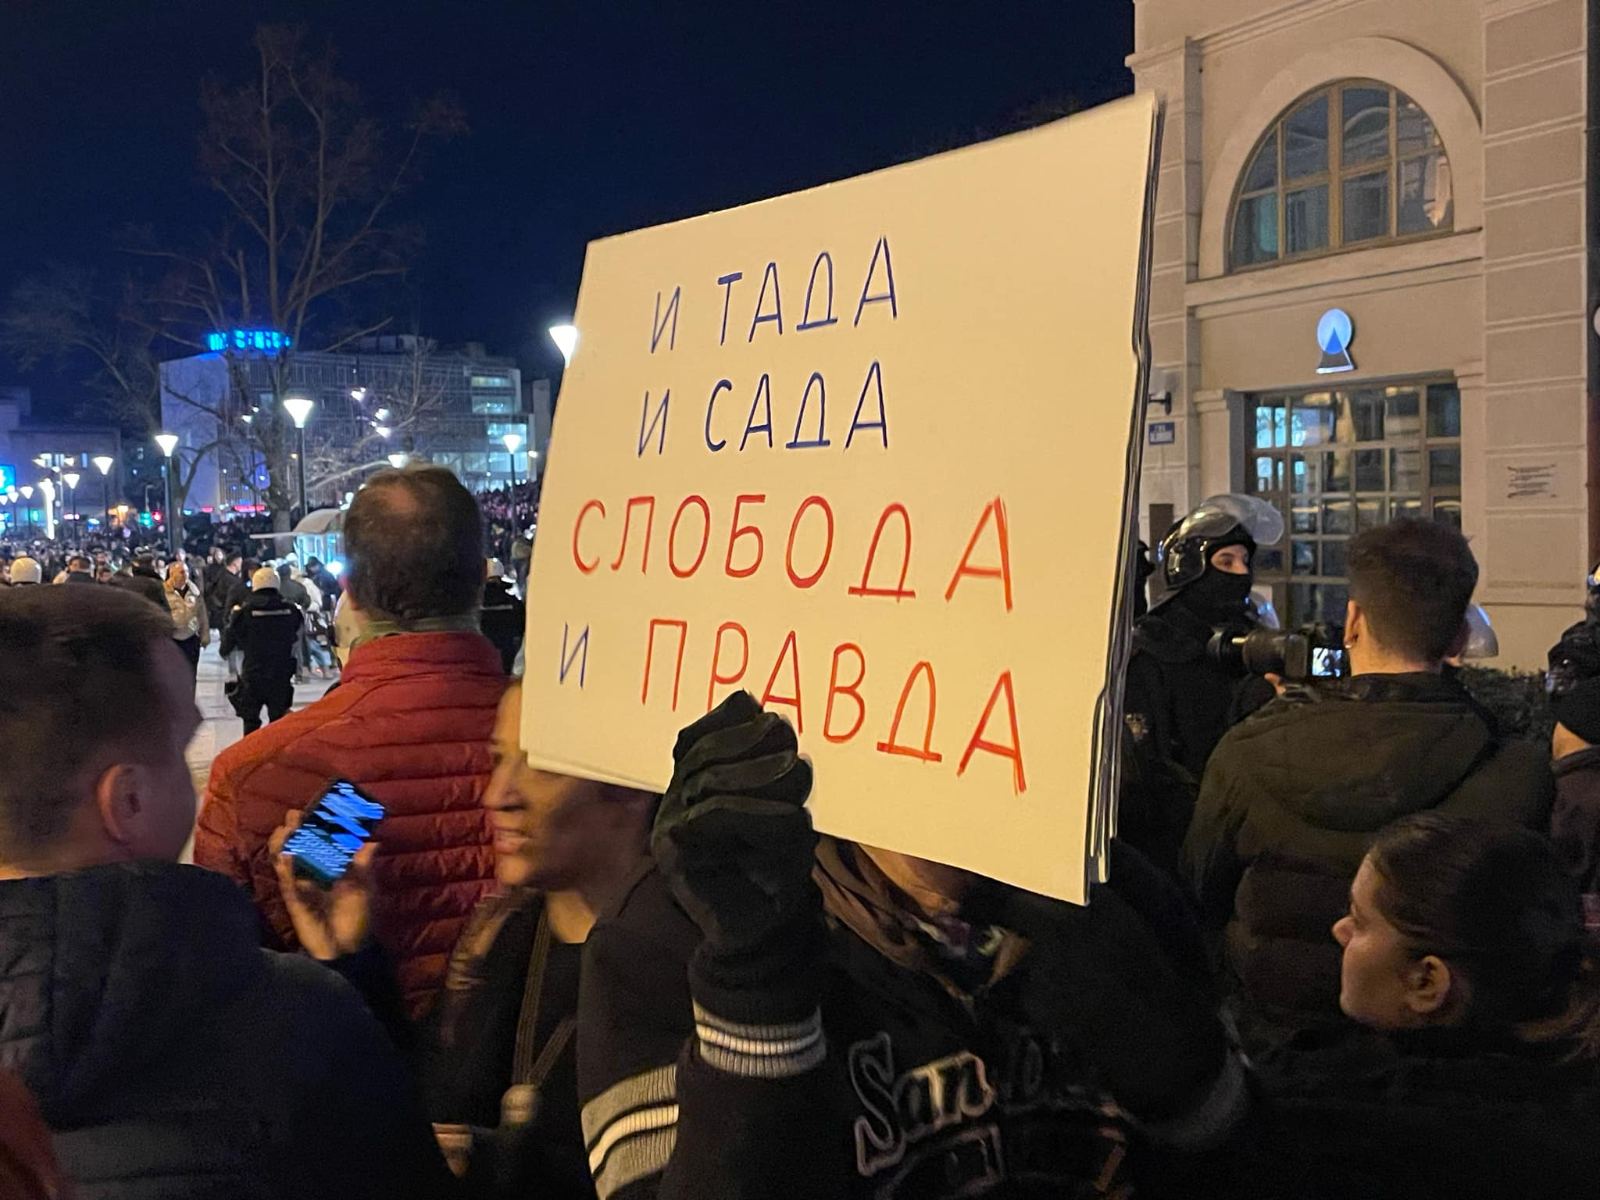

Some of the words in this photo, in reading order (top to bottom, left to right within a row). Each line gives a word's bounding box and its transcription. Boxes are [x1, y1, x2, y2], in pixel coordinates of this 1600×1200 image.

[650, 286, 682, 354] И
[717, 235, 898, 348] ТАДА
[636, 388, 670, 458] И
[703, 360, 889, 454] САДА
[571, 493, 1015, 614] СЛОБОДА
[558, 621, 591, 690] И
[640, 617, 1028, 796] ПРАВДА
